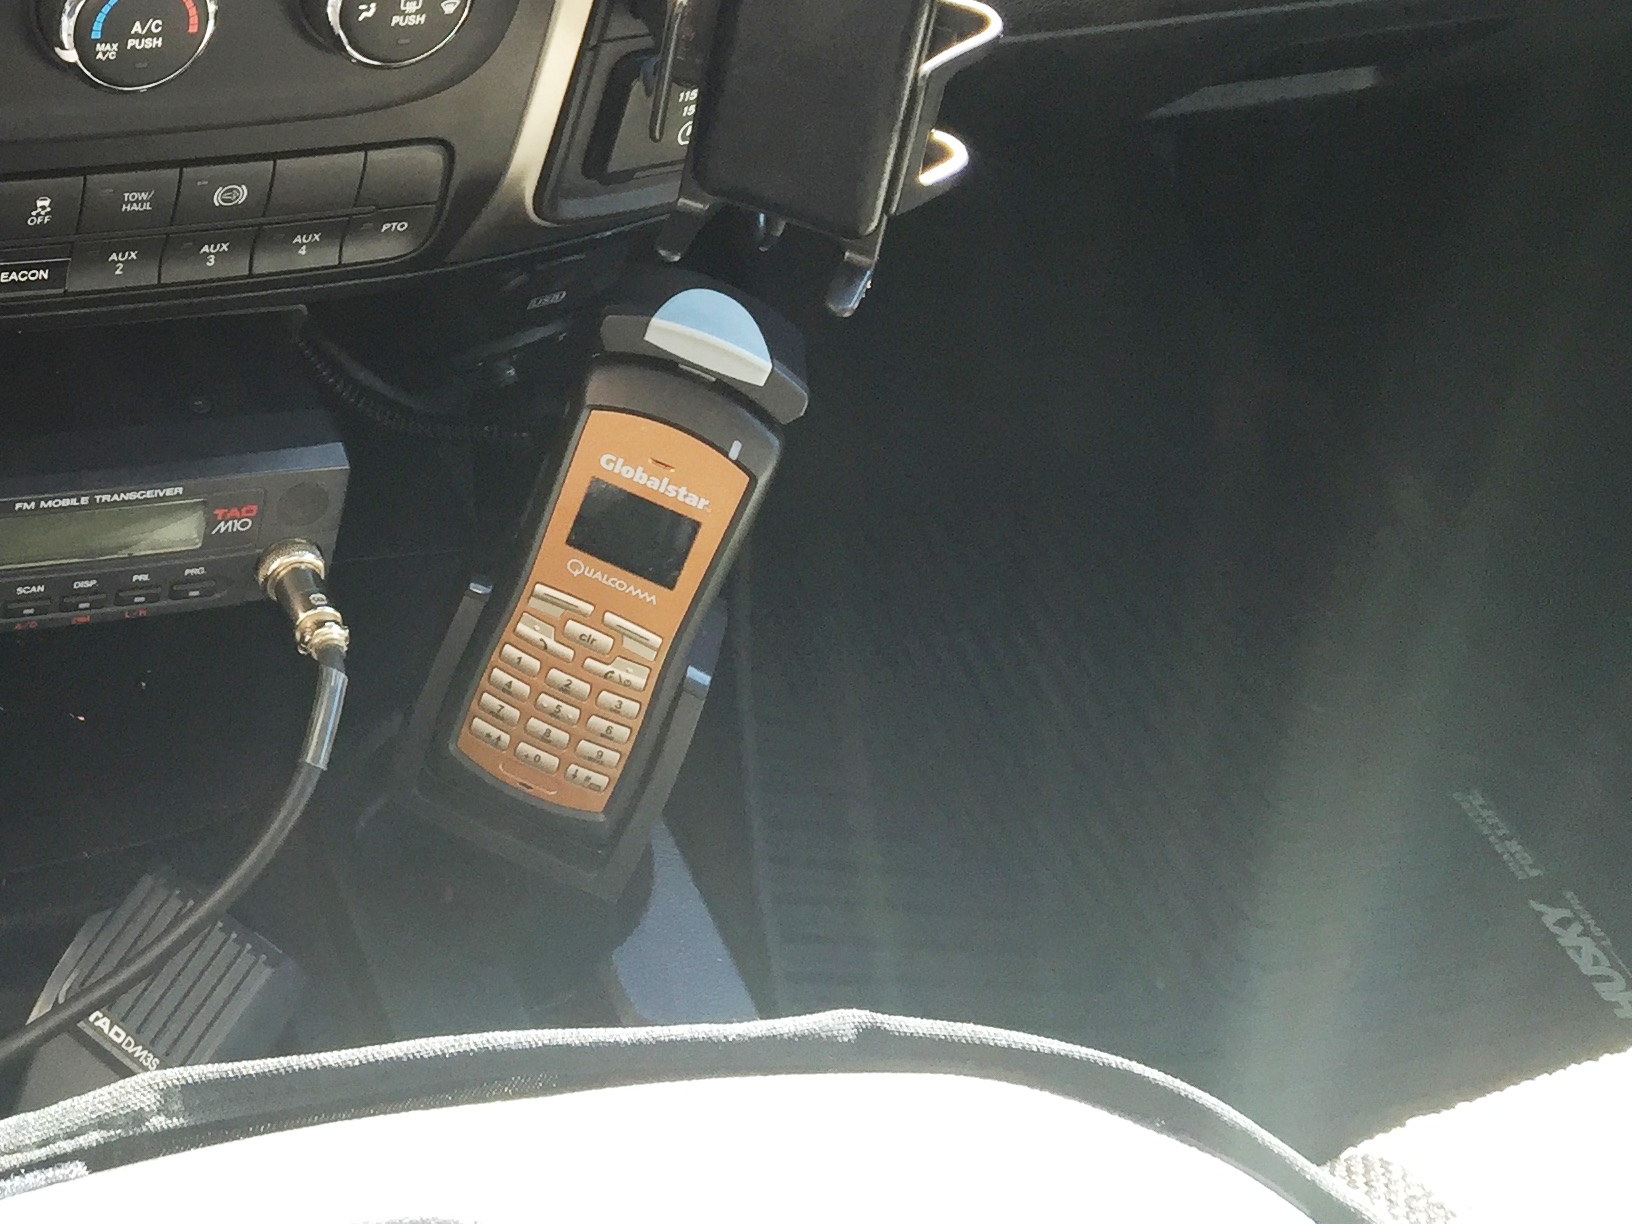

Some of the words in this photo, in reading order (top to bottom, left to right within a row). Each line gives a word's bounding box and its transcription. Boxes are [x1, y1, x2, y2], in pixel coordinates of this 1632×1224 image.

[391, 13, 426, 27] PUSH
[131, 19, 163, 34] A/C
[95, 43, 119, 52] MAX
[126, 36, 162, 50] PUSH
[95, 50, 117, 61] A/C
[678, 88, 699, 103] 115
[122, 190, 154, 202] TOW/
[121, 200, 152, 212] HAUL
[27, 214, 52, 226] OFF
[381, 221, 408, 233] PTO
[292, 232, 321, 245] AUX
[200, 242, 229, 255] AUX
[297, 244, 307, 256] 4
[108, 250, 138, 262] AUX
[206, 254, 216, 266] 3
[114, 262, 124, 274] 2
[599, 453, 710, 510] Globalstar
[14, 502, 36, 511] FM
[39, 495, 89, 510] MOBILE
[95, 486, 184, 504] TRANSCEIVER
[211, 518, 252, 534] M10
[567, 559, 656, 605] QUALCOMM
[16, 585, 45, 596] SCAN
[578, 632, 596, 645] clr
[515, 656, 523, 665] 1
[505, 681, 513, 689] 4
[564, 679, 573, 689] 2
[497, 704, 505, 714] 7
[554, 704, 562, 714] 5
[614, 700, 623, 710] 3
[544, 728, 552, 738] 8
[605, 726, 614, 735] 6
[533, 754, 541, 763] 0
[596, 750, 604, 759] 9
